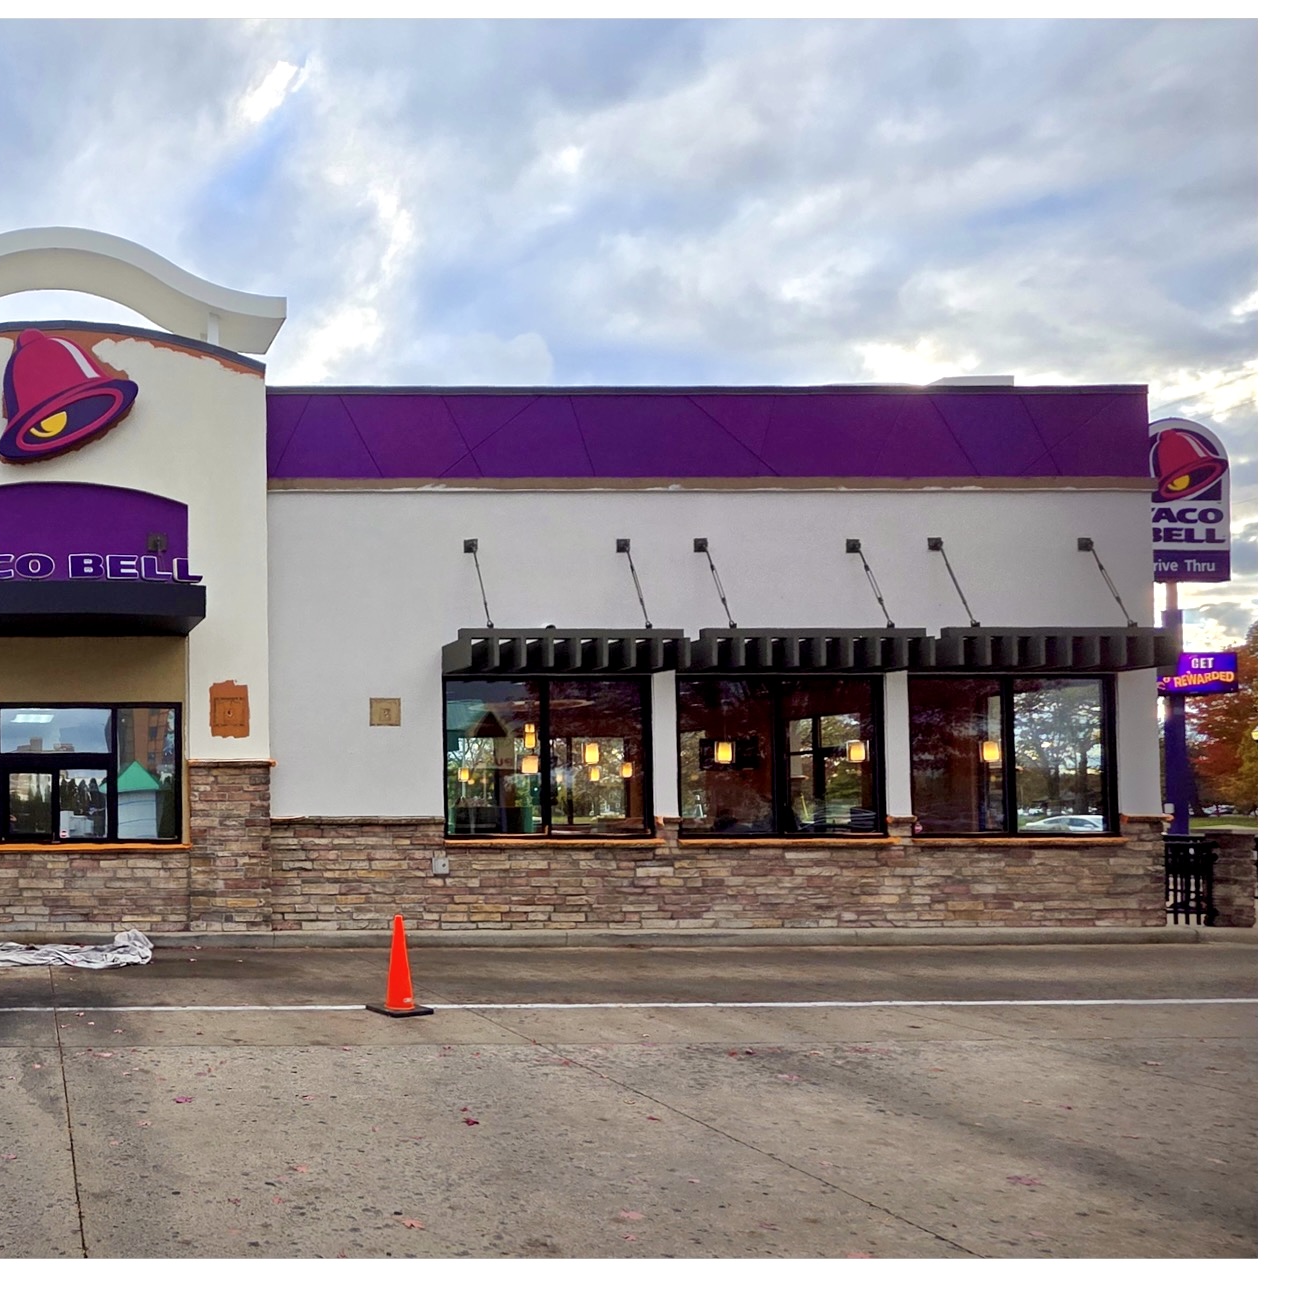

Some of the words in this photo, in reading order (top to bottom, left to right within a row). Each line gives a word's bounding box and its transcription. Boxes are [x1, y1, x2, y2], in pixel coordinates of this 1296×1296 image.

[1151, 507, 1224, 524] ACO
[67, 553, 204, 584] BELL
[1153, 558, 1179, 572] rive
[1184, 558, 1216, 572] Thru
[1190, 657, 1215, 669] GET
[1173, 671, 1235, 688] REWARDED
